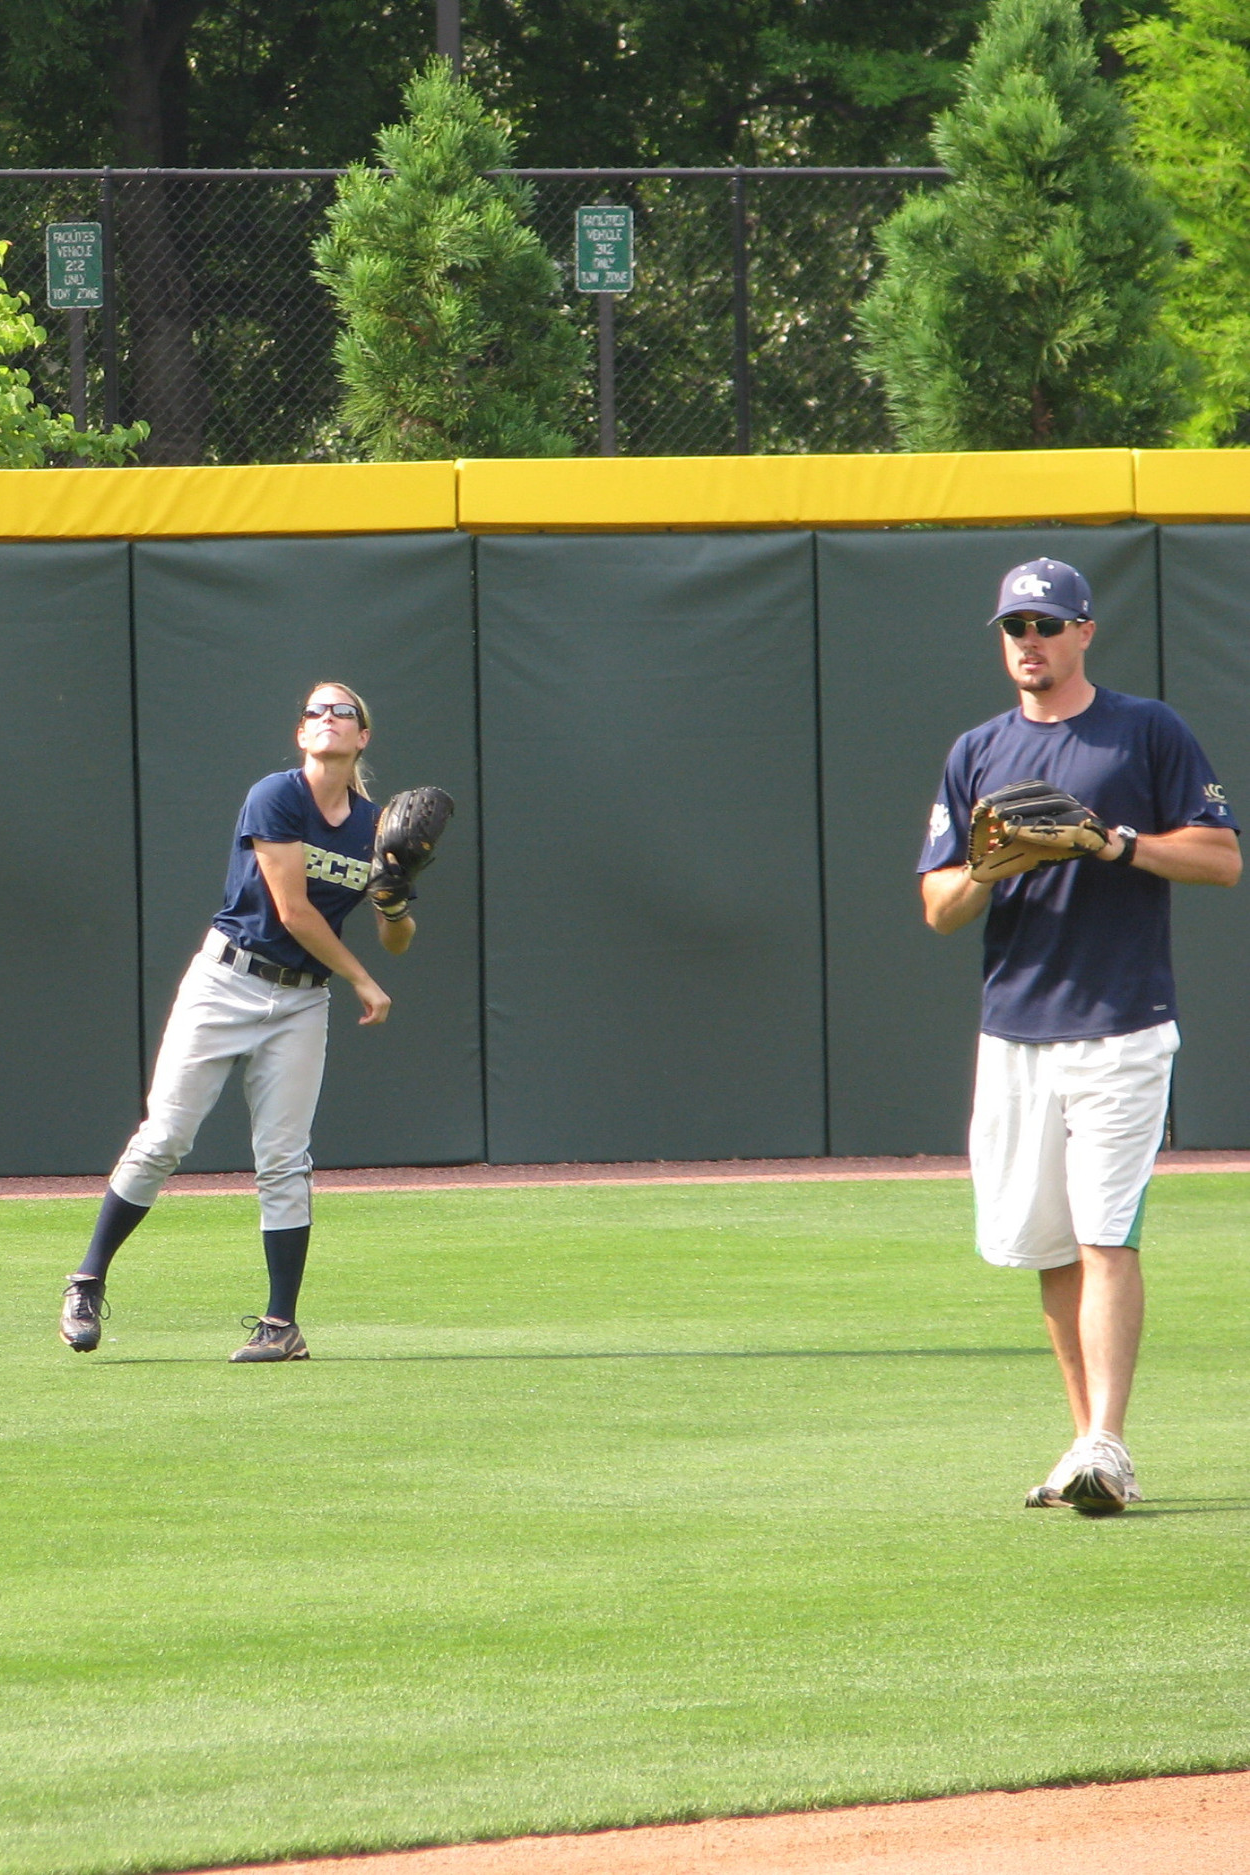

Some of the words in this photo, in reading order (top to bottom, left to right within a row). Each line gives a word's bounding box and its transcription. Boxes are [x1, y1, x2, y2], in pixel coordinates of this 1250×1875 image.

[53, 231, 96, 242] FACILITIES
[586, 229, 623, 241] VEHICLE
[57, 246, 93, 257] VEHICLE
[592, 257, 616, 269] ONLY
[64, 274, 86, 286] ONLY
[605, 271, 628, 283] ZONE
[76, 287, 99, 299] ZONE
